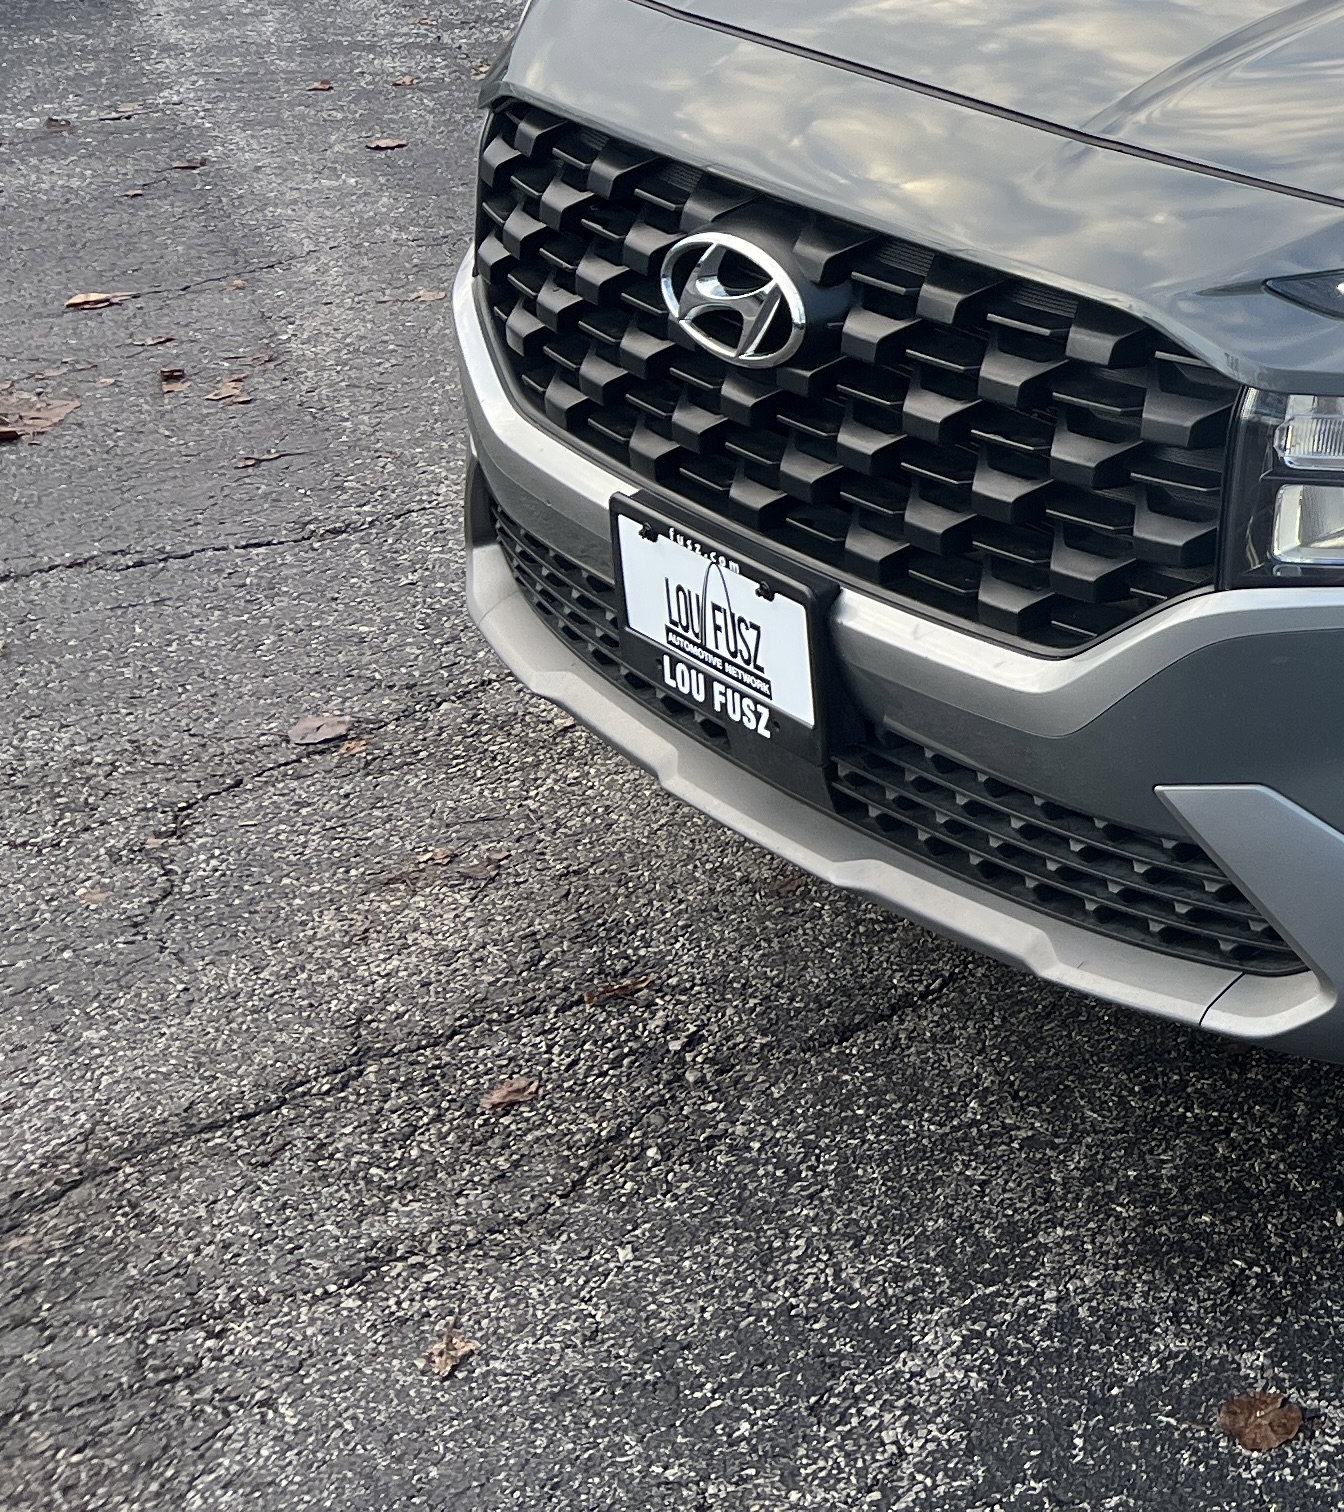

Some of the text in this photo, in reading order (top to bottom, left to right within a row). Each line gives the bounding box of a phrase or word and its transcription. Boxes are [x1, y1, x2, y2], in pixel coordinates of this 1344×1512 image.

[668, 527, 741, 575] fusz.com
[665, 577, 765, 674] LOU FUSZ
[663, 654, 771, 739] LOU FUSZ
[667, 631, 771, 696] AUTOMOTIVE NETWORK
